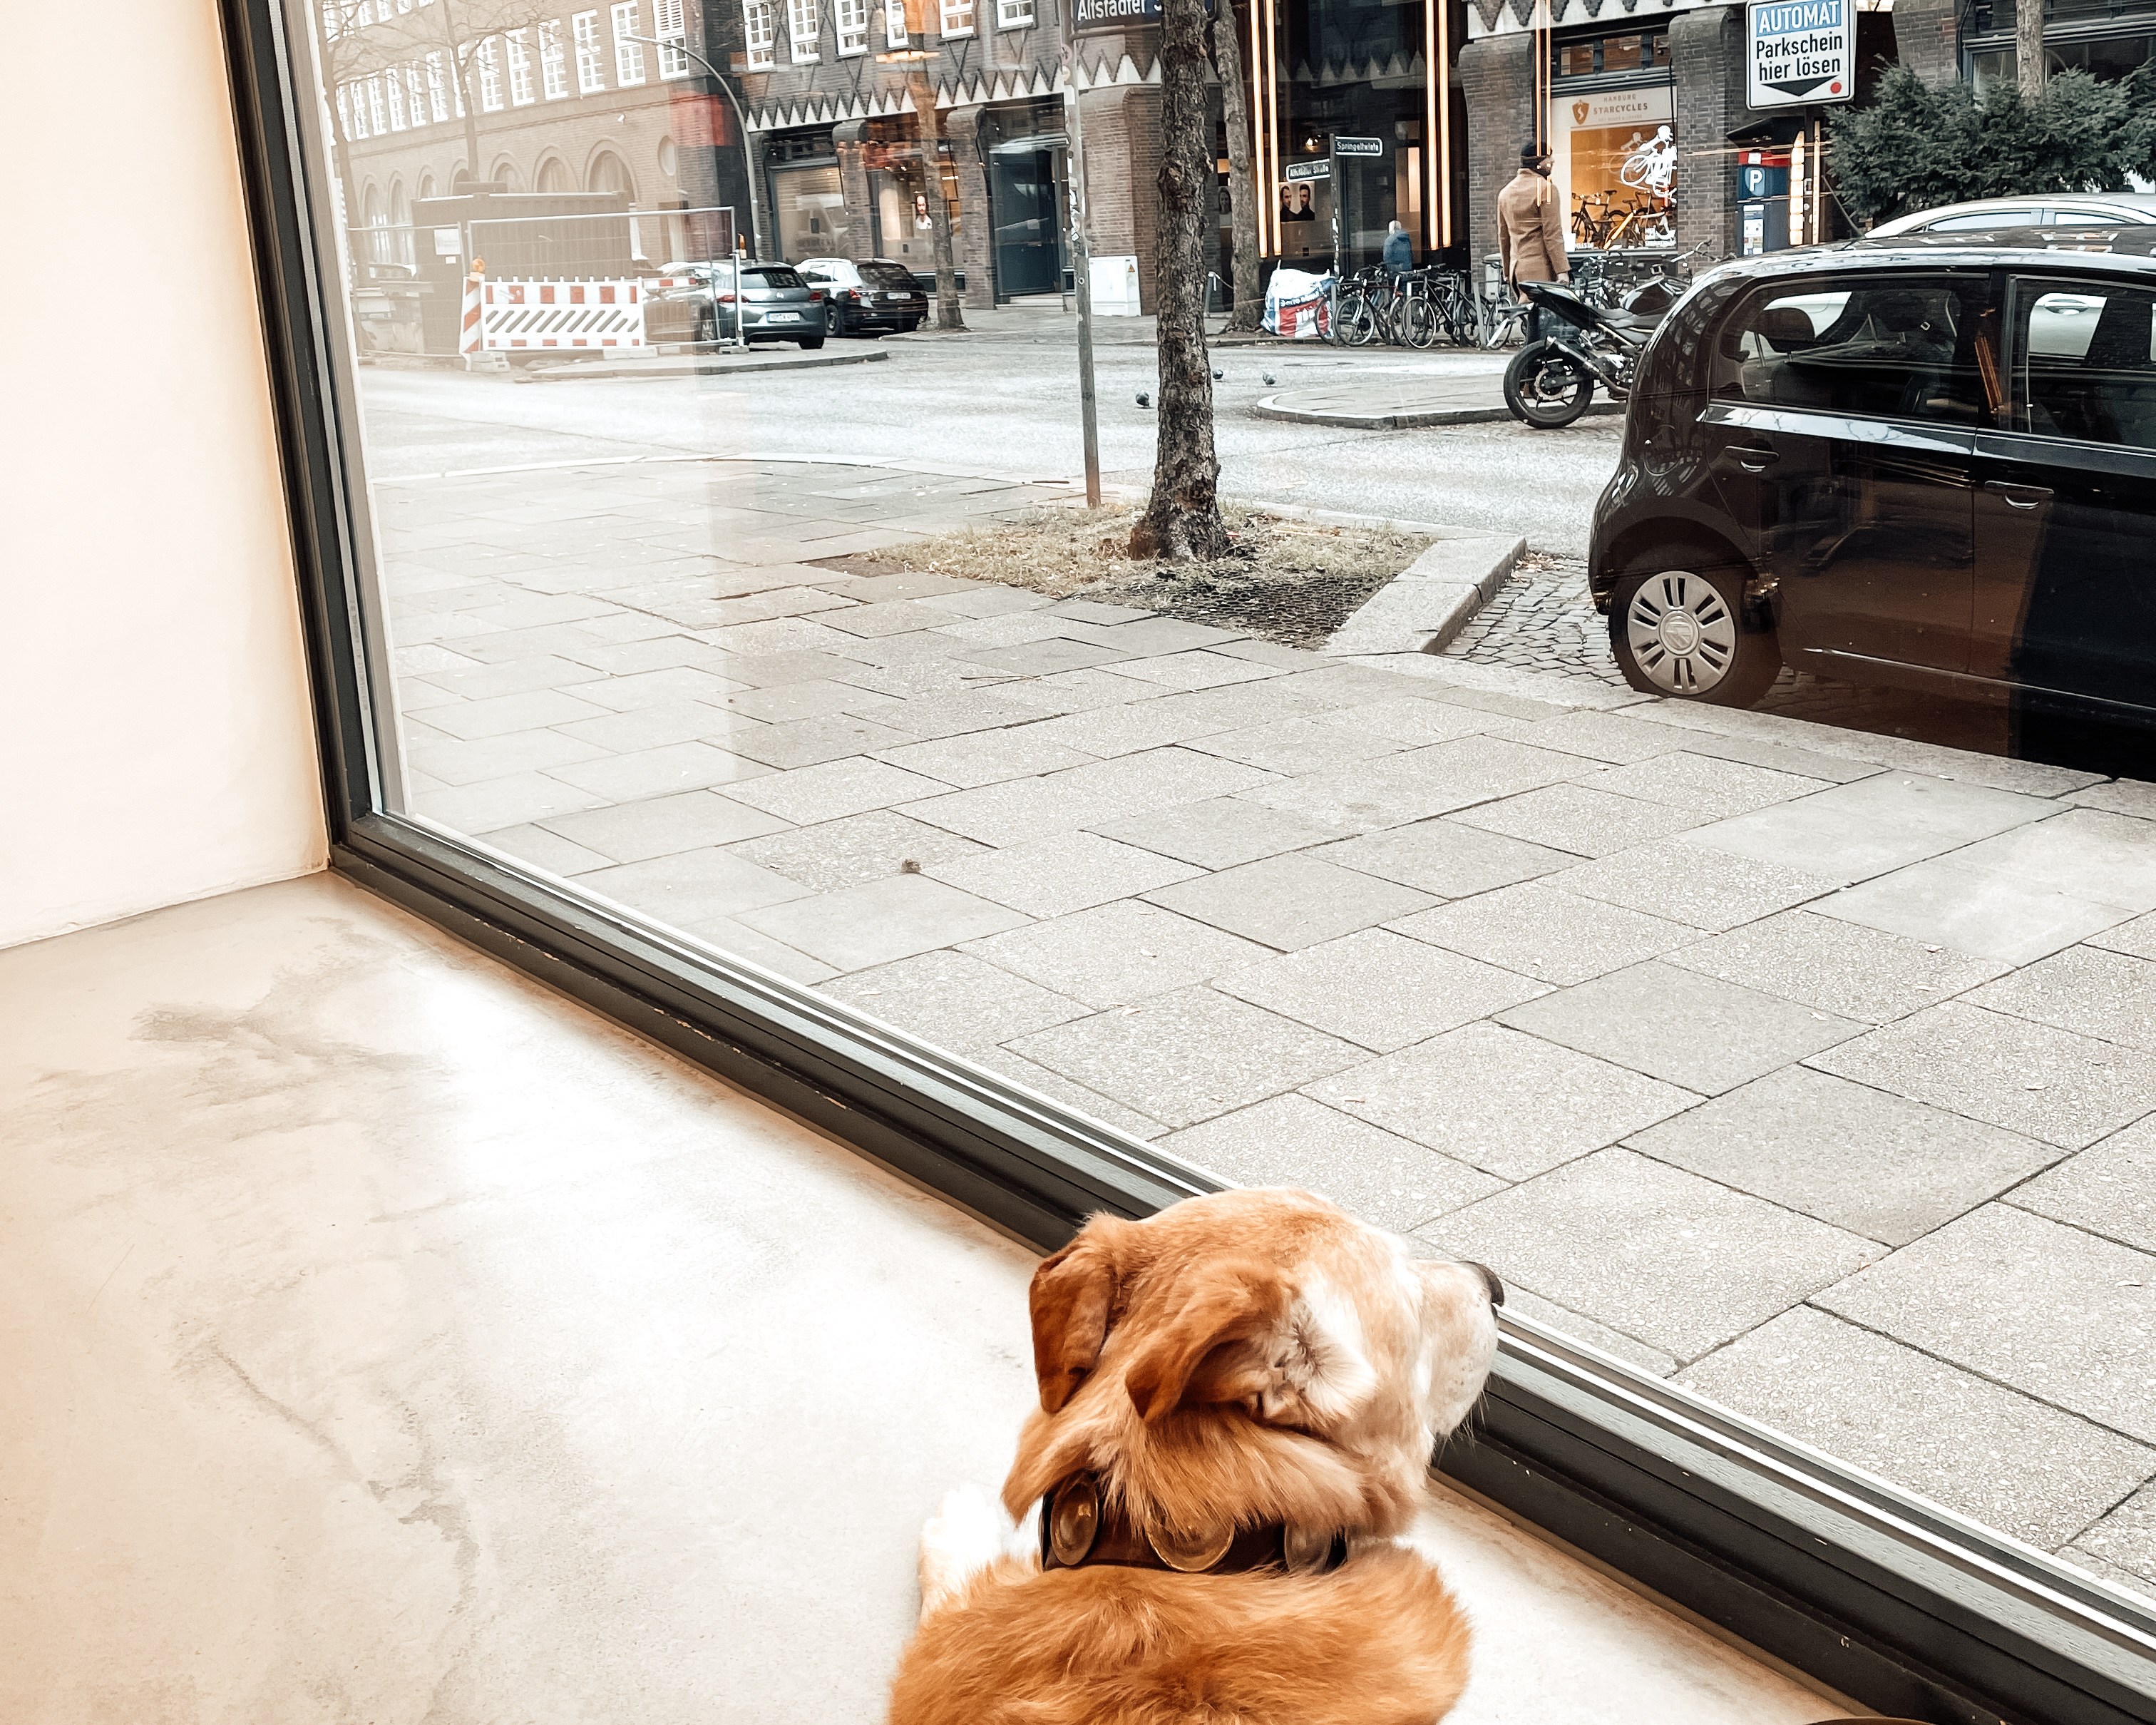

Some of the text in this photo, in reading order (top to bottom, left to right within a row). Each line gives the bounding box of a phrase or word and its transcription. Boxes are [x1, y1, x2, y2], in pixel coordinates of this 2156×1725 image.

[1758, 1, 1839, 34] AUTOMAT
[1756, 31, 1842, 59] Parkschein
[1759, 56, 1840, 81] hier lösen
[1593, 103, 1648, 115] STARCYCLES
